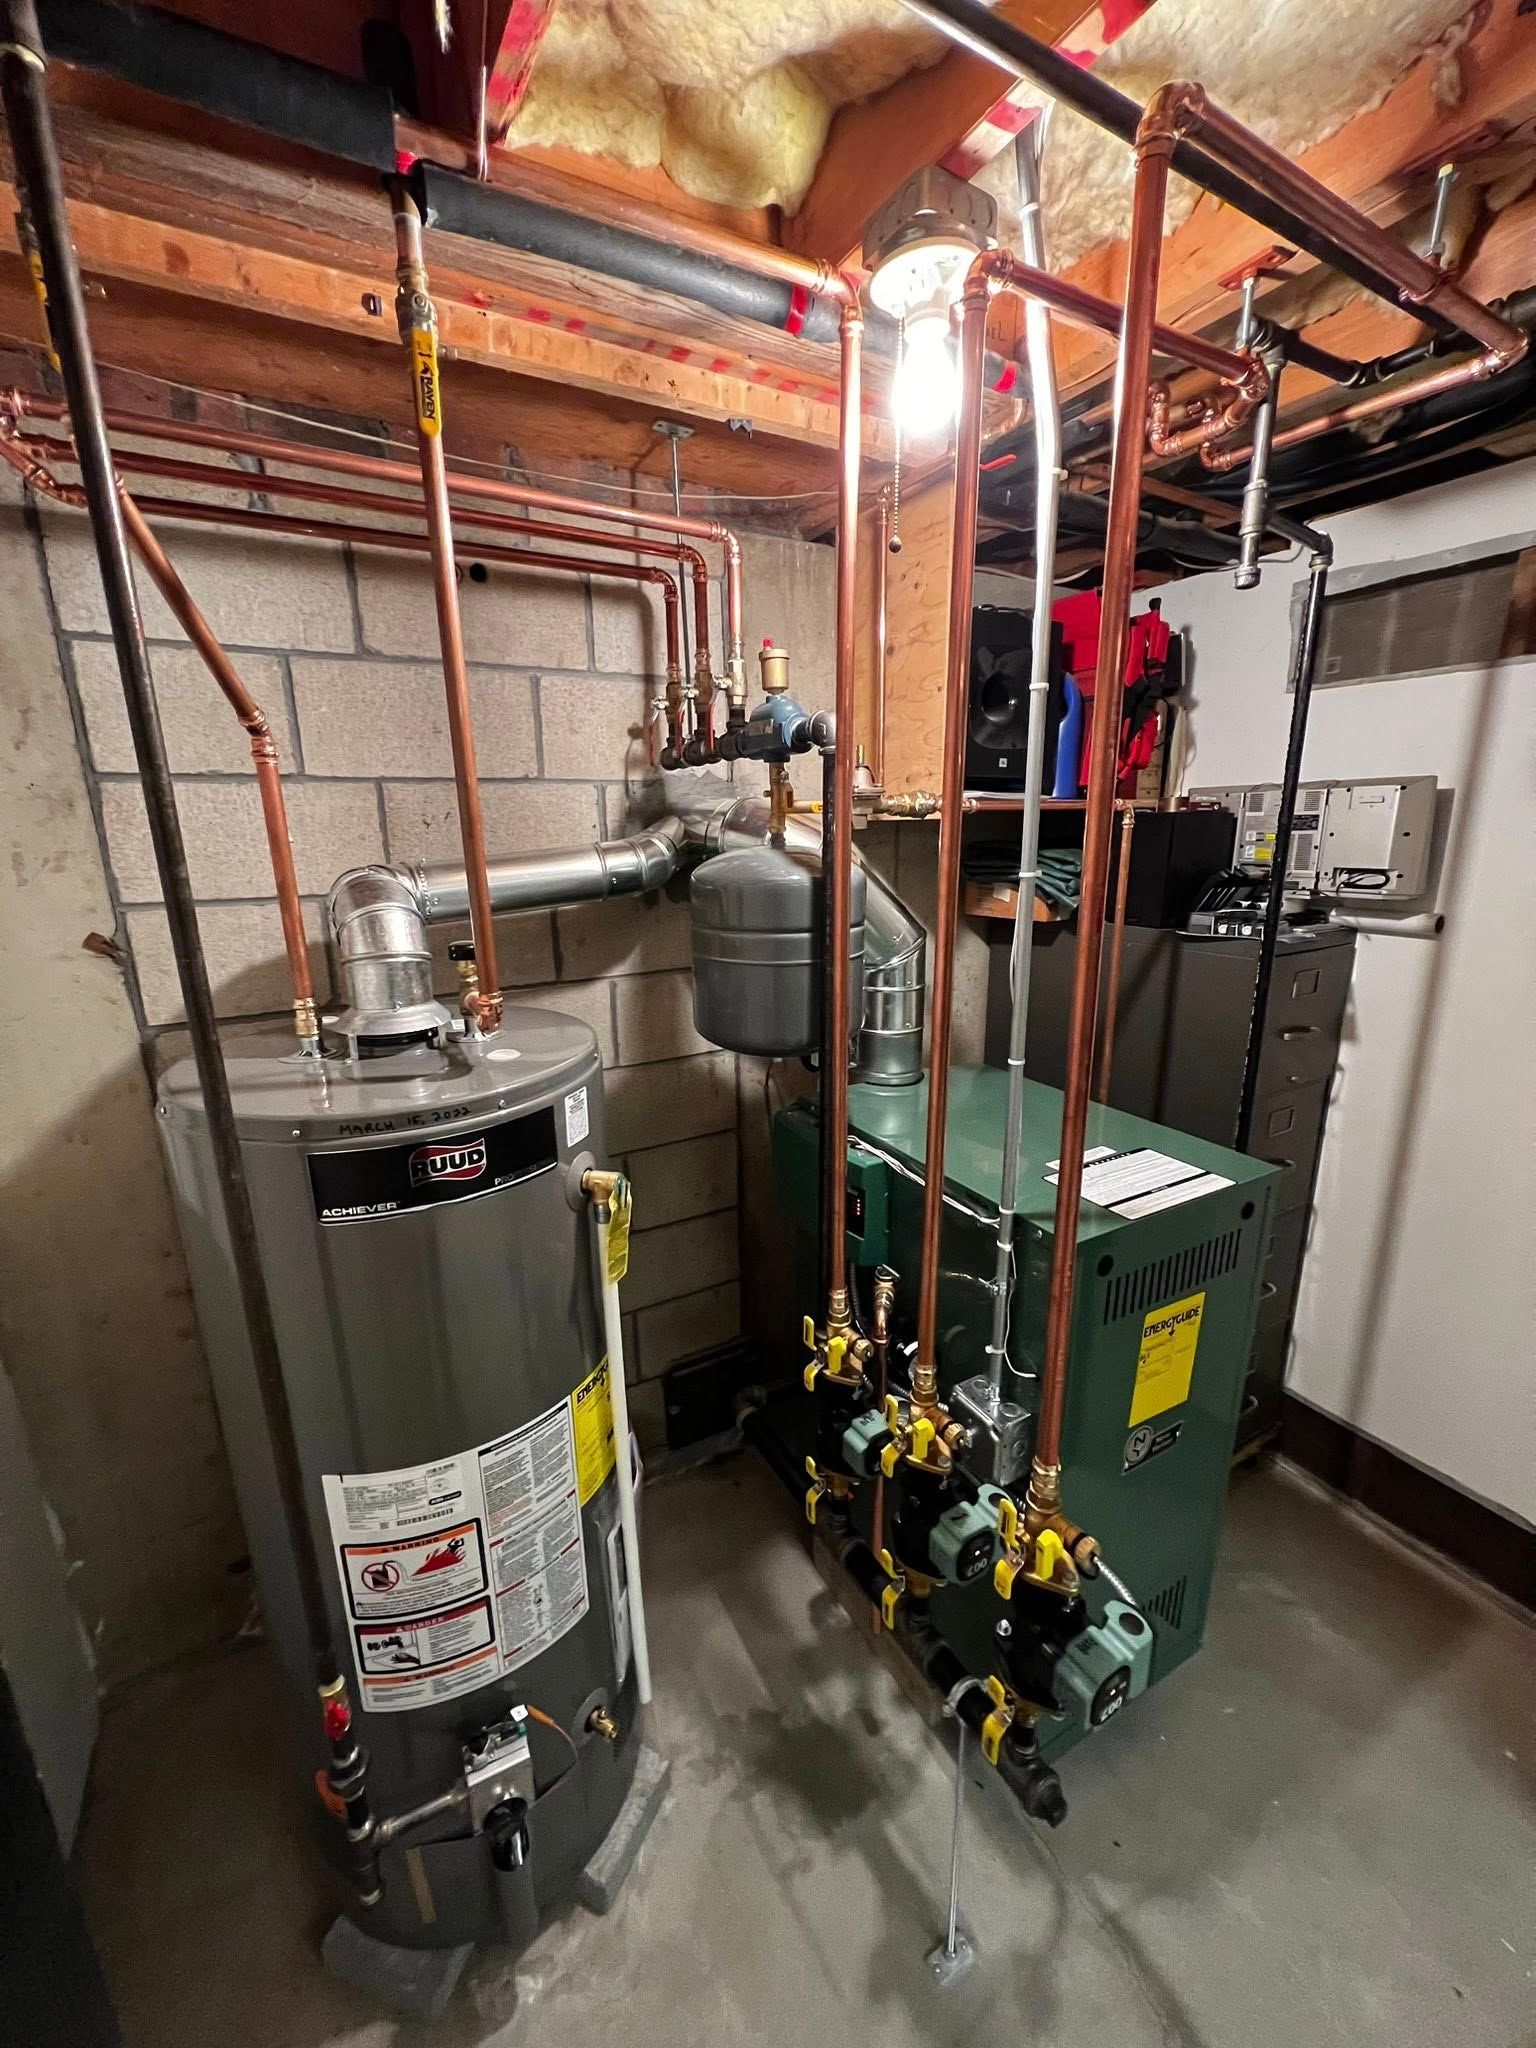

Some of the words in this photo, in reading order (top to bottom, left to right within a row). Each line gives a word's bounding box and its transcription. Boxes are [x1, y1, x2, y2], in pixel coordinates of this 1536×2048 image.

[422, 376, 436, 420] RAVEN
[339, 1121, 395, 1135] MARCH
[432, 1106, 471, 1121] 2022
[411, 1148, 485, 1178] RUUD
[322, 1202, 397, 1216] ACHIEVER
[392, 1537, 440, 1551] WARNING
[404, 1616, 444, 1631] DANGER
